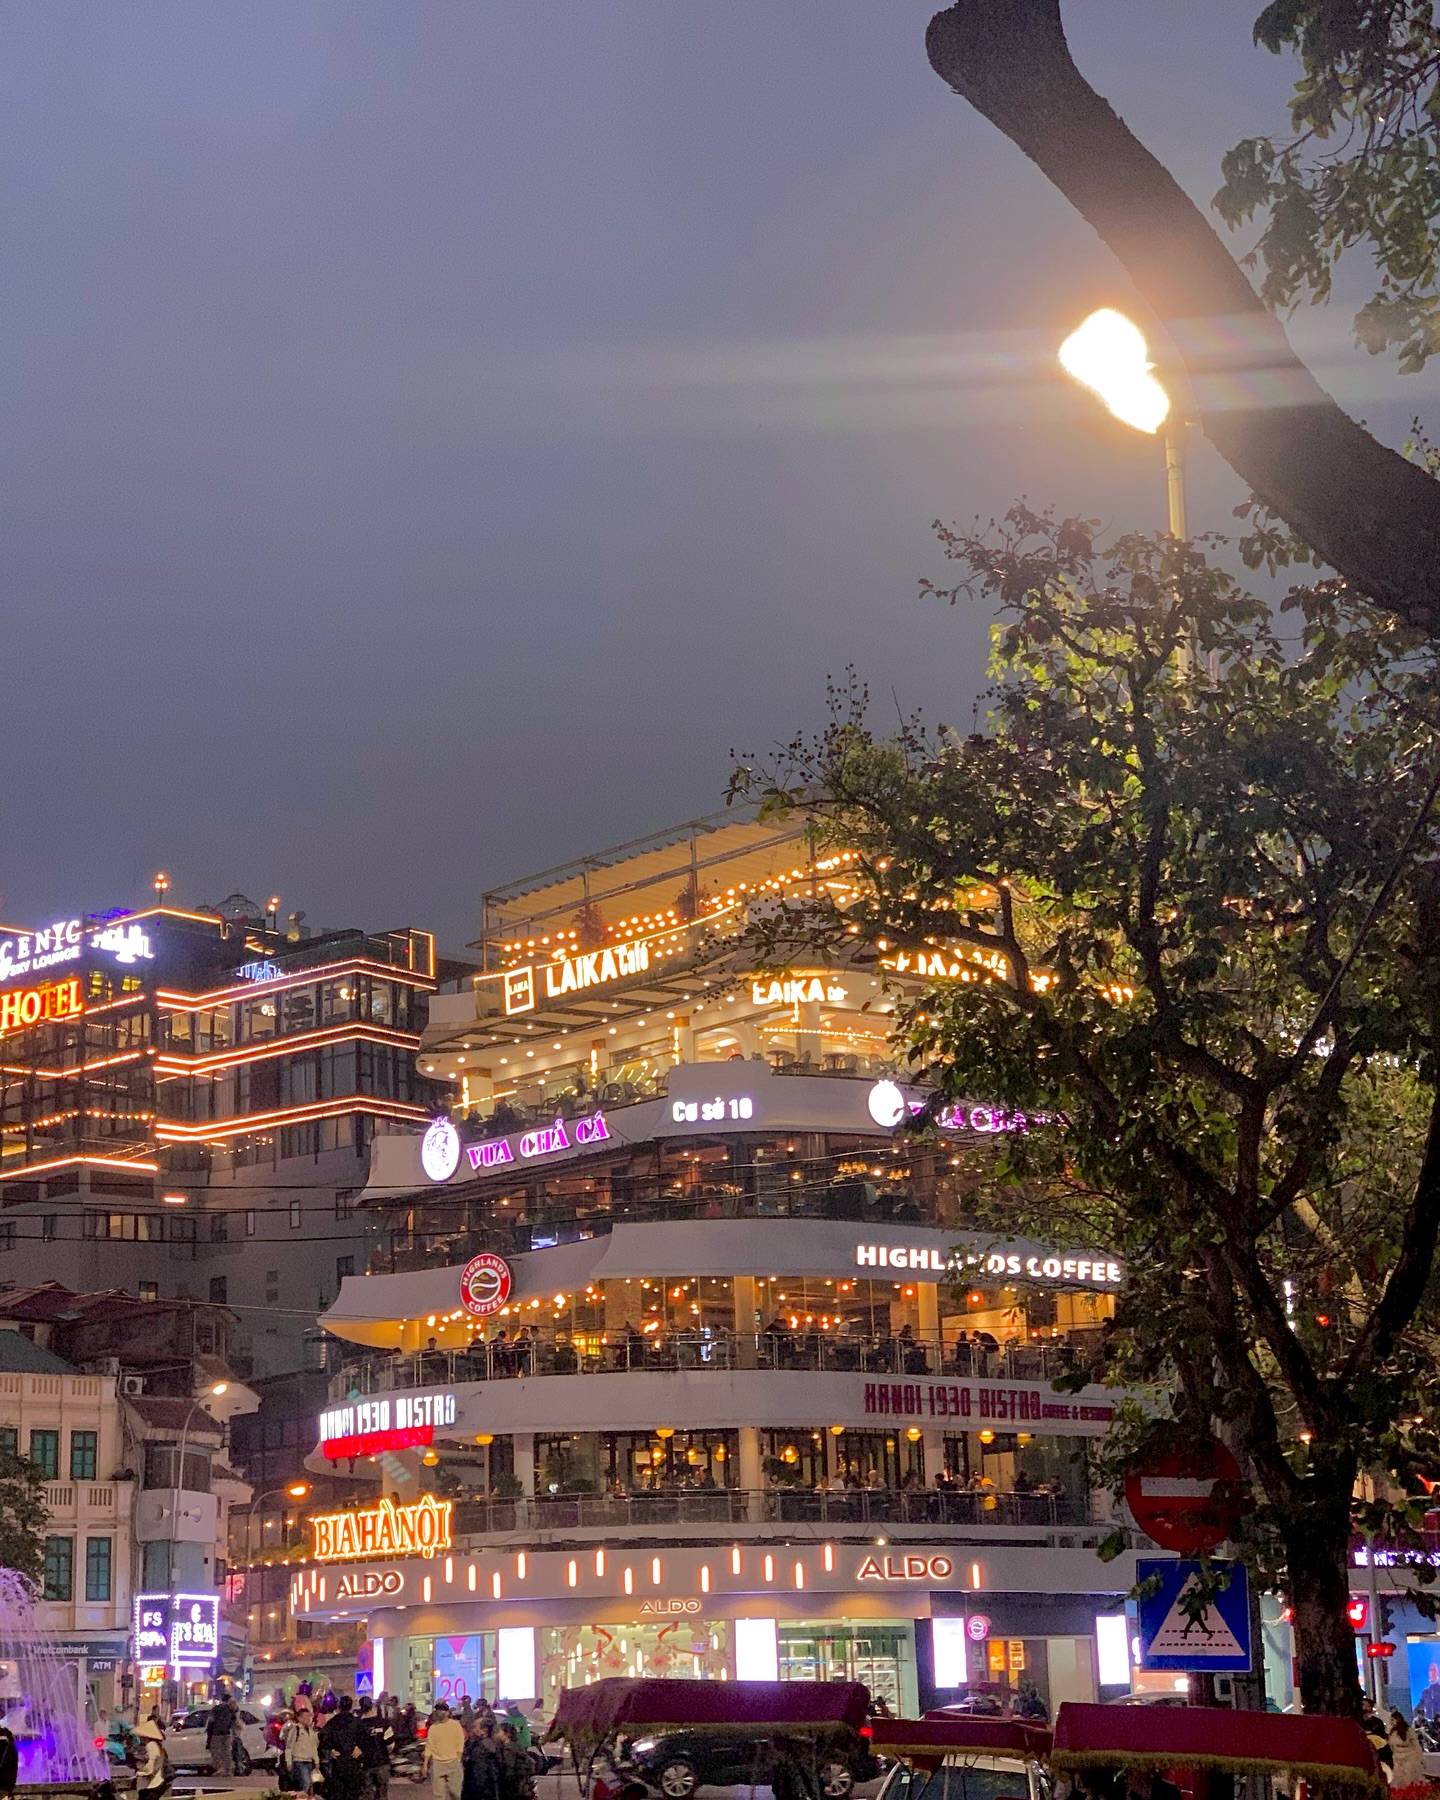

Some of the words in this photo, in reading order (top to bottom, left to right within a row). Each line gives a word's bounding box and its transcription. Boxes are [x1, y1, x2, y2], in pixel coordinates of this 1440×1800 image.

[33, 946, 80, 969] LOUNGE
[546, 949, 618, 997] LAIKA
[752, 978, 825, 1004] LAIKA
[0, 981, 82, 1030] HOTEL
[729, 1097, 753, 1119] 10
[467, 1139, 514, 1170] VUA
[520, 1119, 571, 1157] CHẢ
[576, 1110, 610, 1144] CÁ
[463, 1258, 507, 1286] HIGHLANDS
[1026, 1257, 1121, 1282] COFFEE
[469, 1294, 504, 1313] COFFEE
[864, 1383, 922, 1415] HANOI
[928, 1385, 971, 1417] 1930
[979, 1388, 1041, 1420] BISTRO
[357, 1400, 390, 1434] 1930
[396, 1394, 455, 1429] BISTRO
[857, 1556, 953, 1580] ALDO
[336, 1571, 404, 1599] ALDO
[640, 1599, 702, 1614] ALDO
[143, 1611, 162, 1627] FS
[33, 1644, 88, 1655] Vietcombank
[140, 1631, 167, 1647] SPA
[93, 1661, 111, 1670] ATM
[441, 1678, 466, 1702] 20
